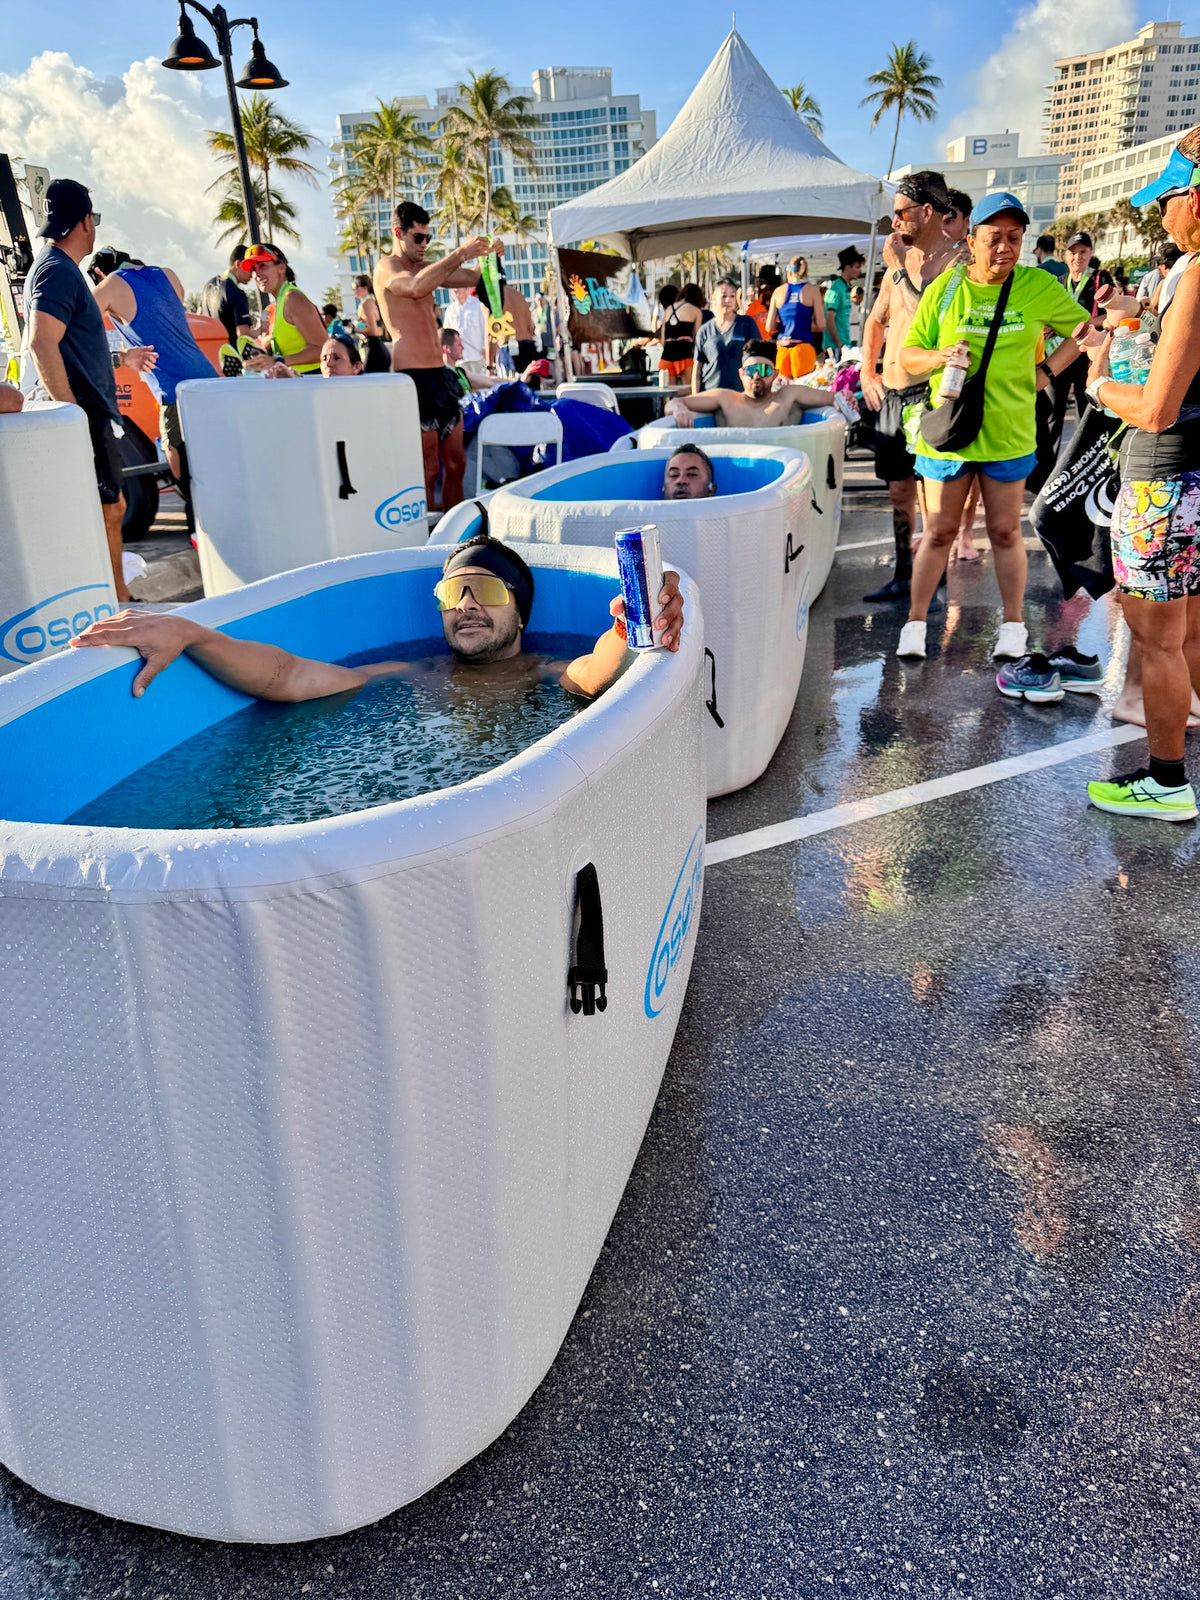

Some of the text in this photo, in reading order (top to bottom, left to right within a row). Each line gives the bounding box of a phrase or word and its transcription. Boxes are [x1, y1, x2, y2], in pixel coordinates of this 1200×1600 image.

[973, 138, 988, 155] B
[115, 384, 132, 394] AC
[1070, 431, 1110, 475] 54-MORE
